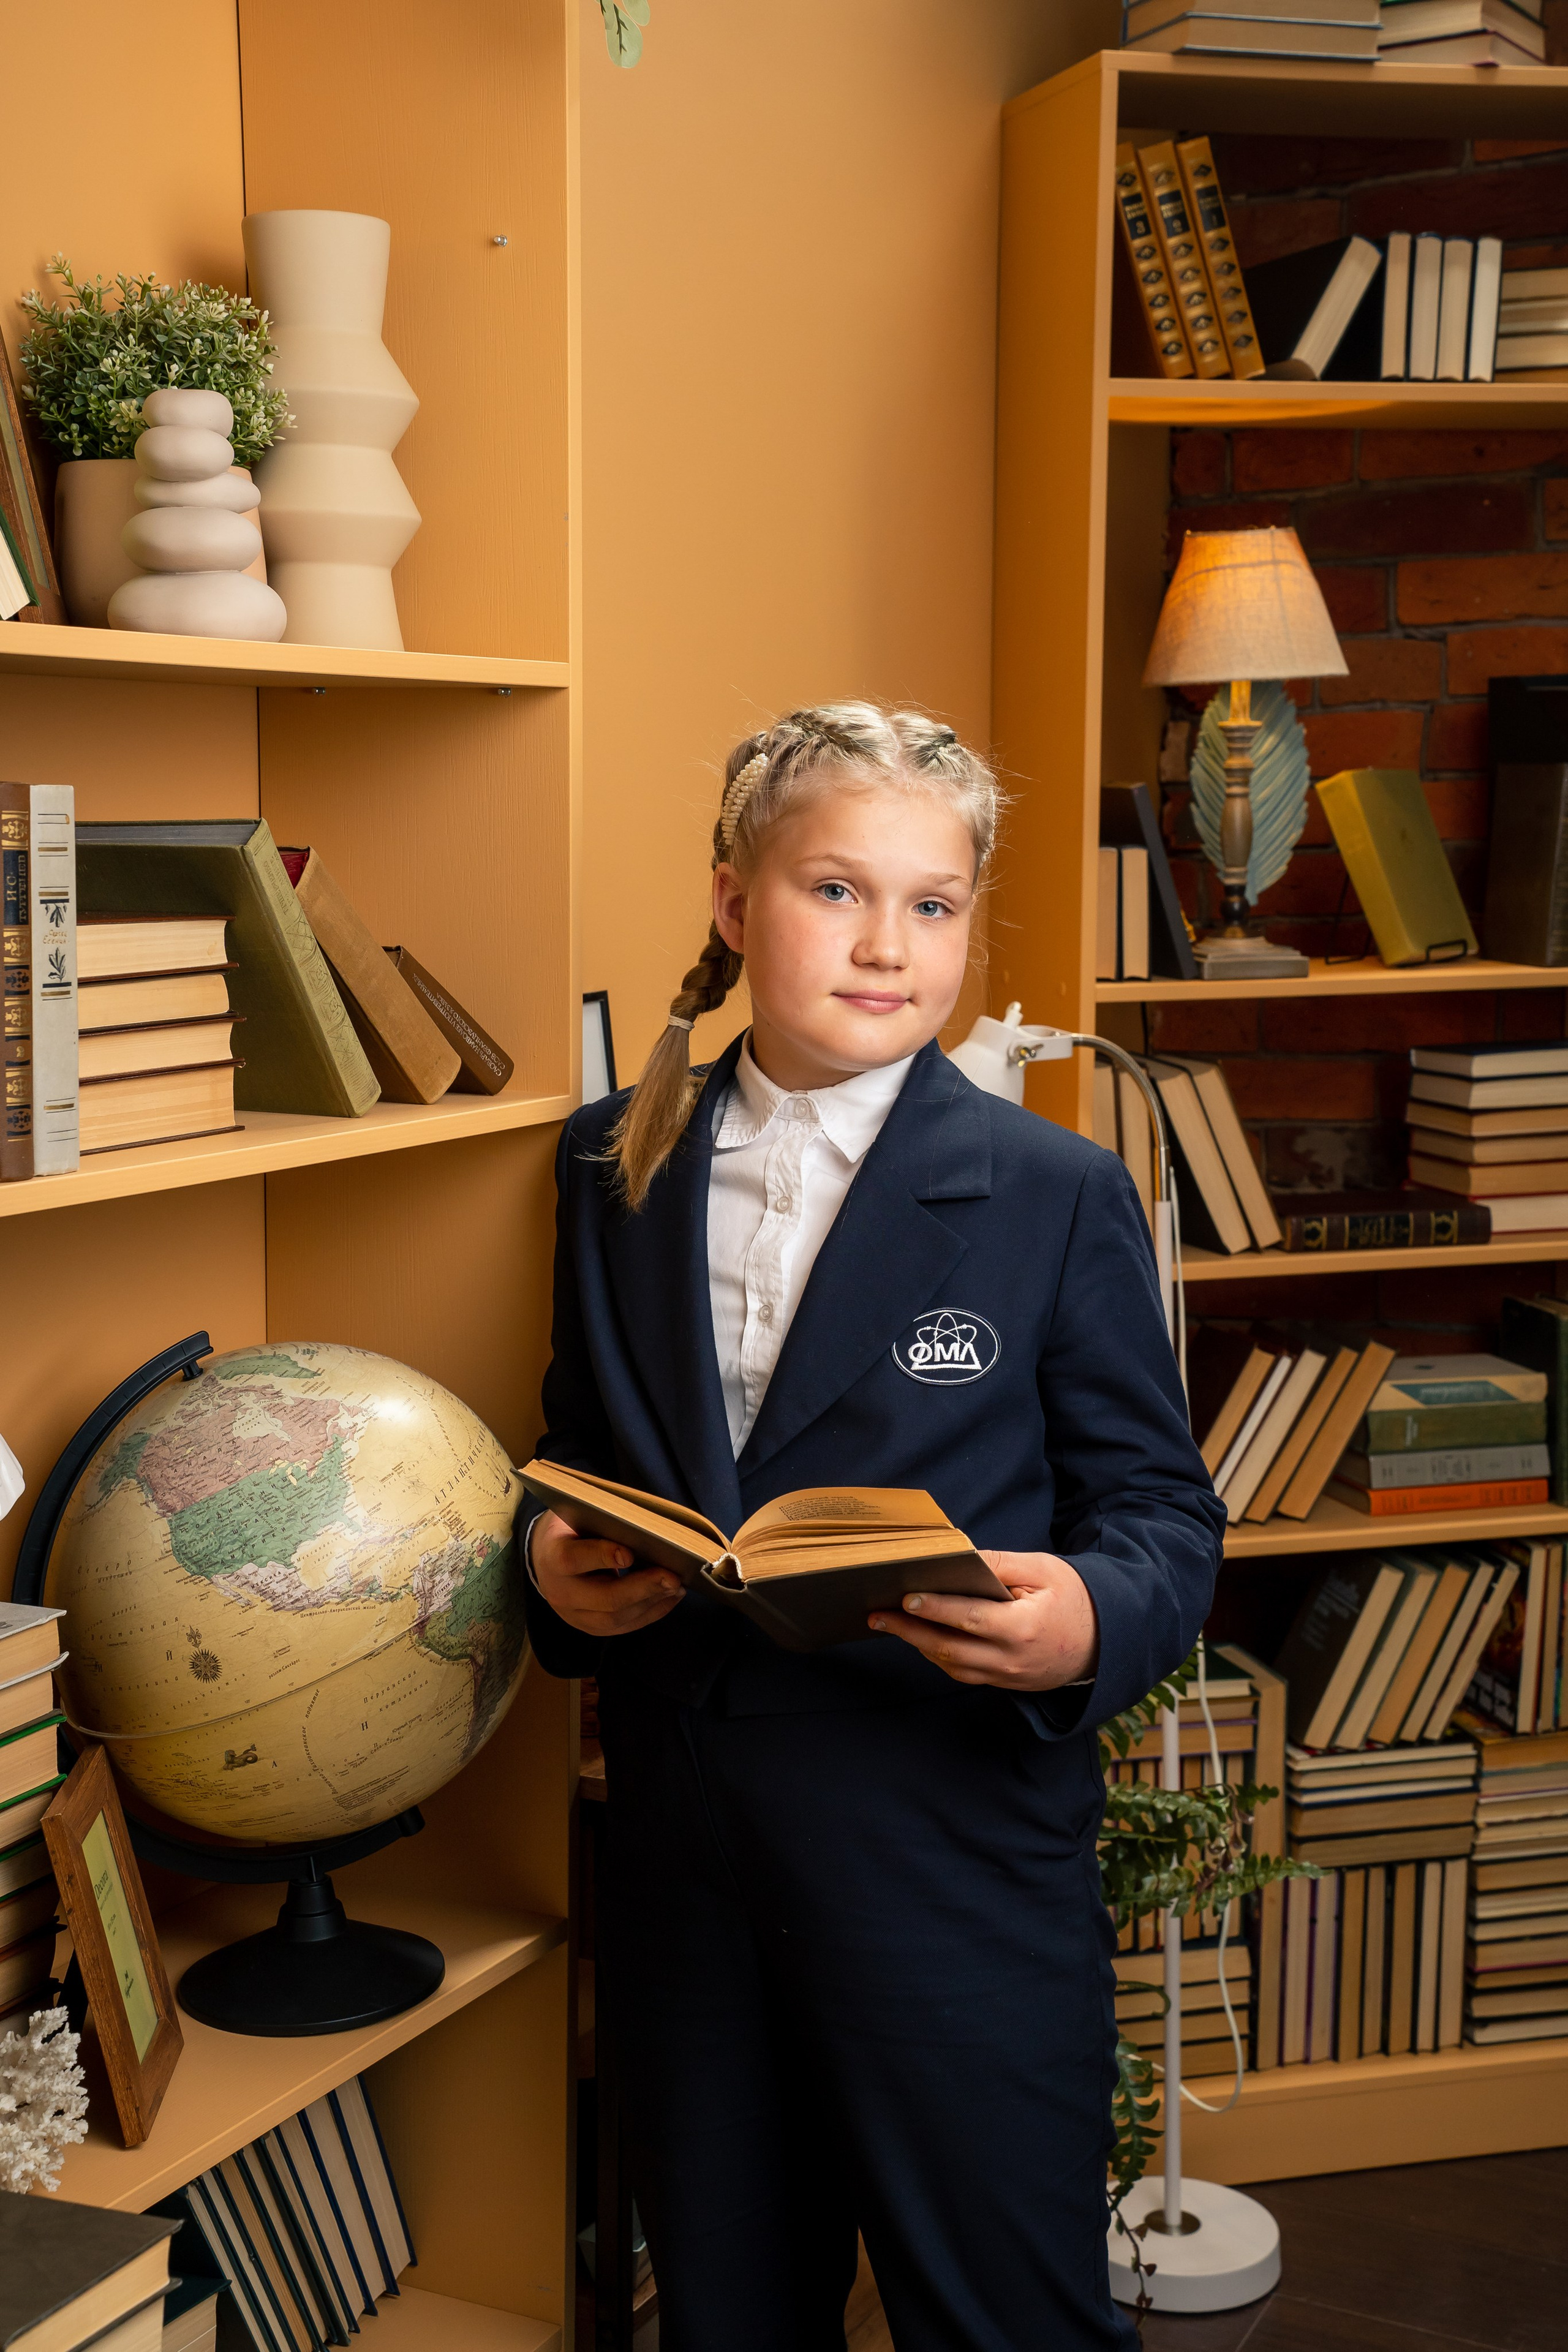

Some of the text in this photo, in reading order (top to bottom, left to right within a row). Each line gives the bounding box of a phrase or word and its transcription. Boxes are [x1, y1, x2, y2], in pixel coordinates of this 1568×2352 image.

[412, 973, 502, 1077] СЛОВАРЬ НАИБОЛЕЕ УПОТРЕБИТЕЛЬНЫХ
[436, 992, 506, 1071] СЛОВ ФРАНЦУЗСКОГО ЯЗЫКА
[232, 1506, 282, 1534] ШТАТЫ
[219, 1526, 286, 1565] АМЕРИКИ
[250, 1570, 282, 1589] МЕКСИКА
[90, 1616, 179, 1642] Восточная
[362, 1669, 428, 1713] Перуанская котловина
[302, 1689, 339, 1795] Восточно-Тихоокеанское поднятие
[94, 1869, 109, 1901] Decora
